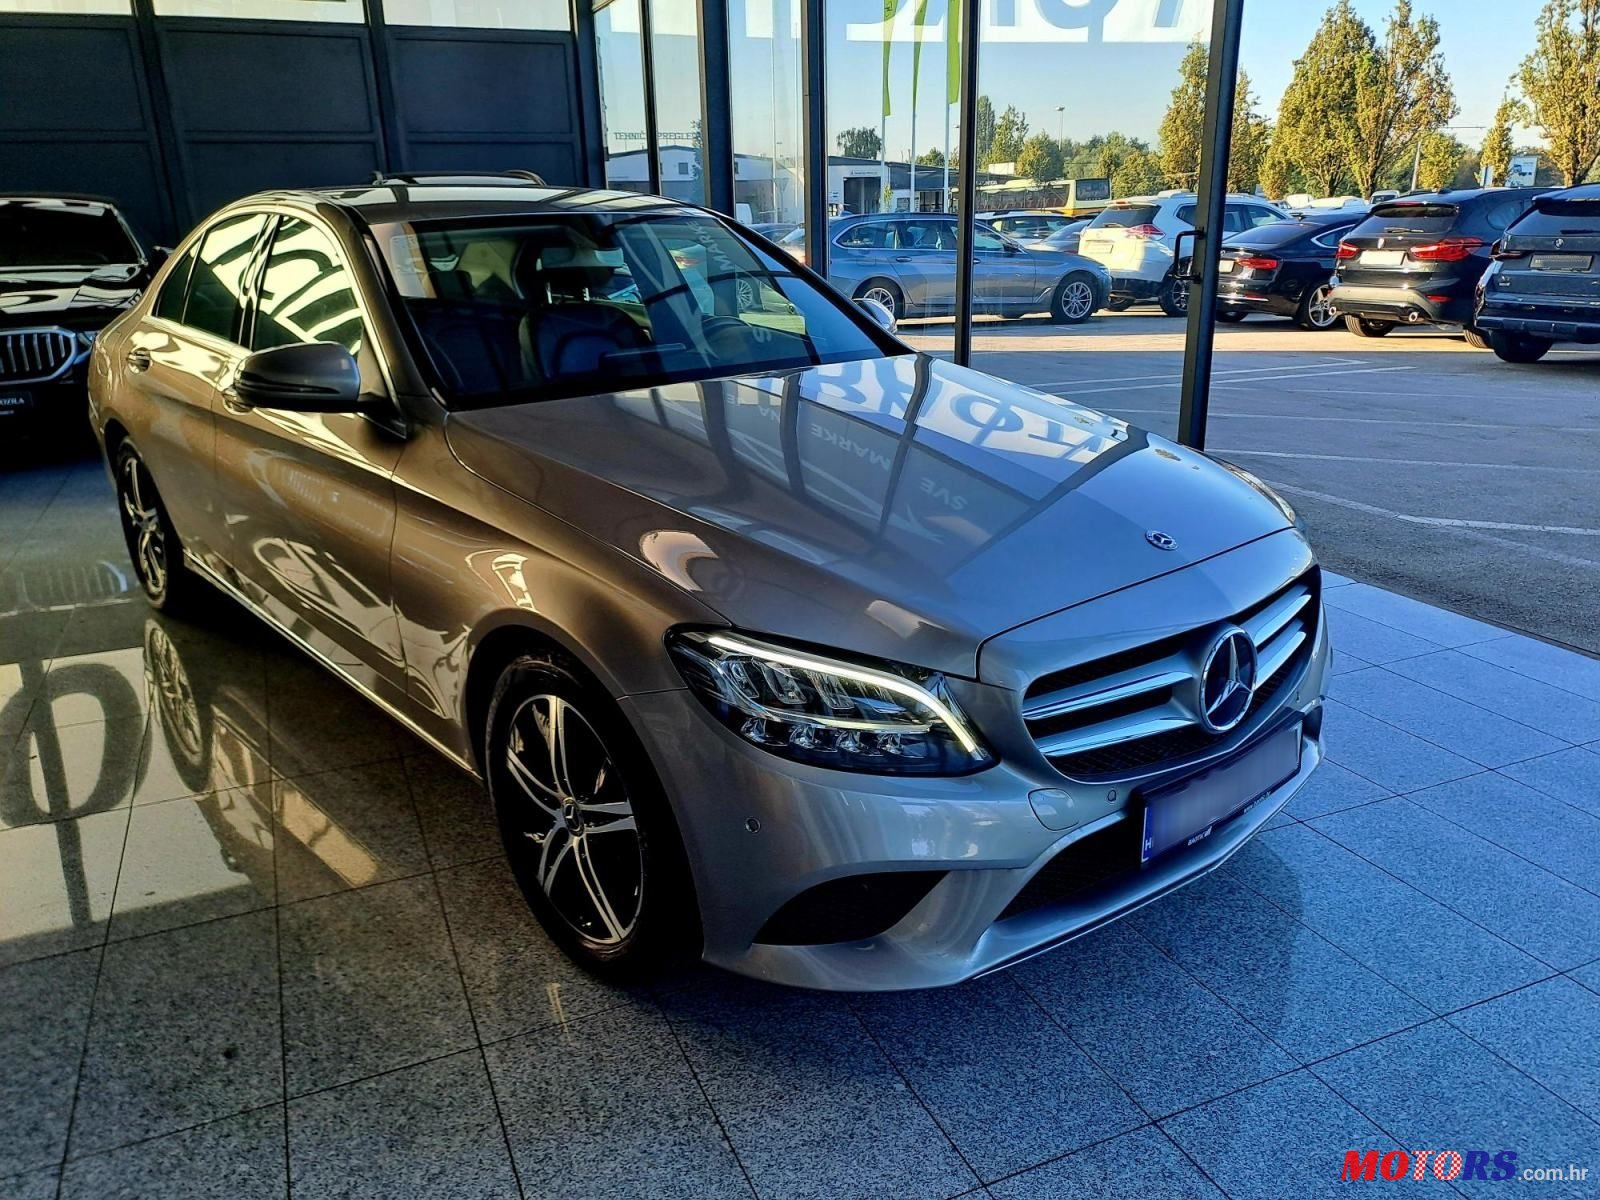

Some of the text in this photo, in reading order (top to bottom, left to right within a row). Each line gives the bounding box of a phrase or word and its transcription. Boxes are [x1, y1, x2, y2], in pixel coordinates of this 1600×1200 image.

[614, 130, 649, 140] TEHNIČ
[809, 423, 892, 471] MARKE
[919, 477, 968, 510] SVE
